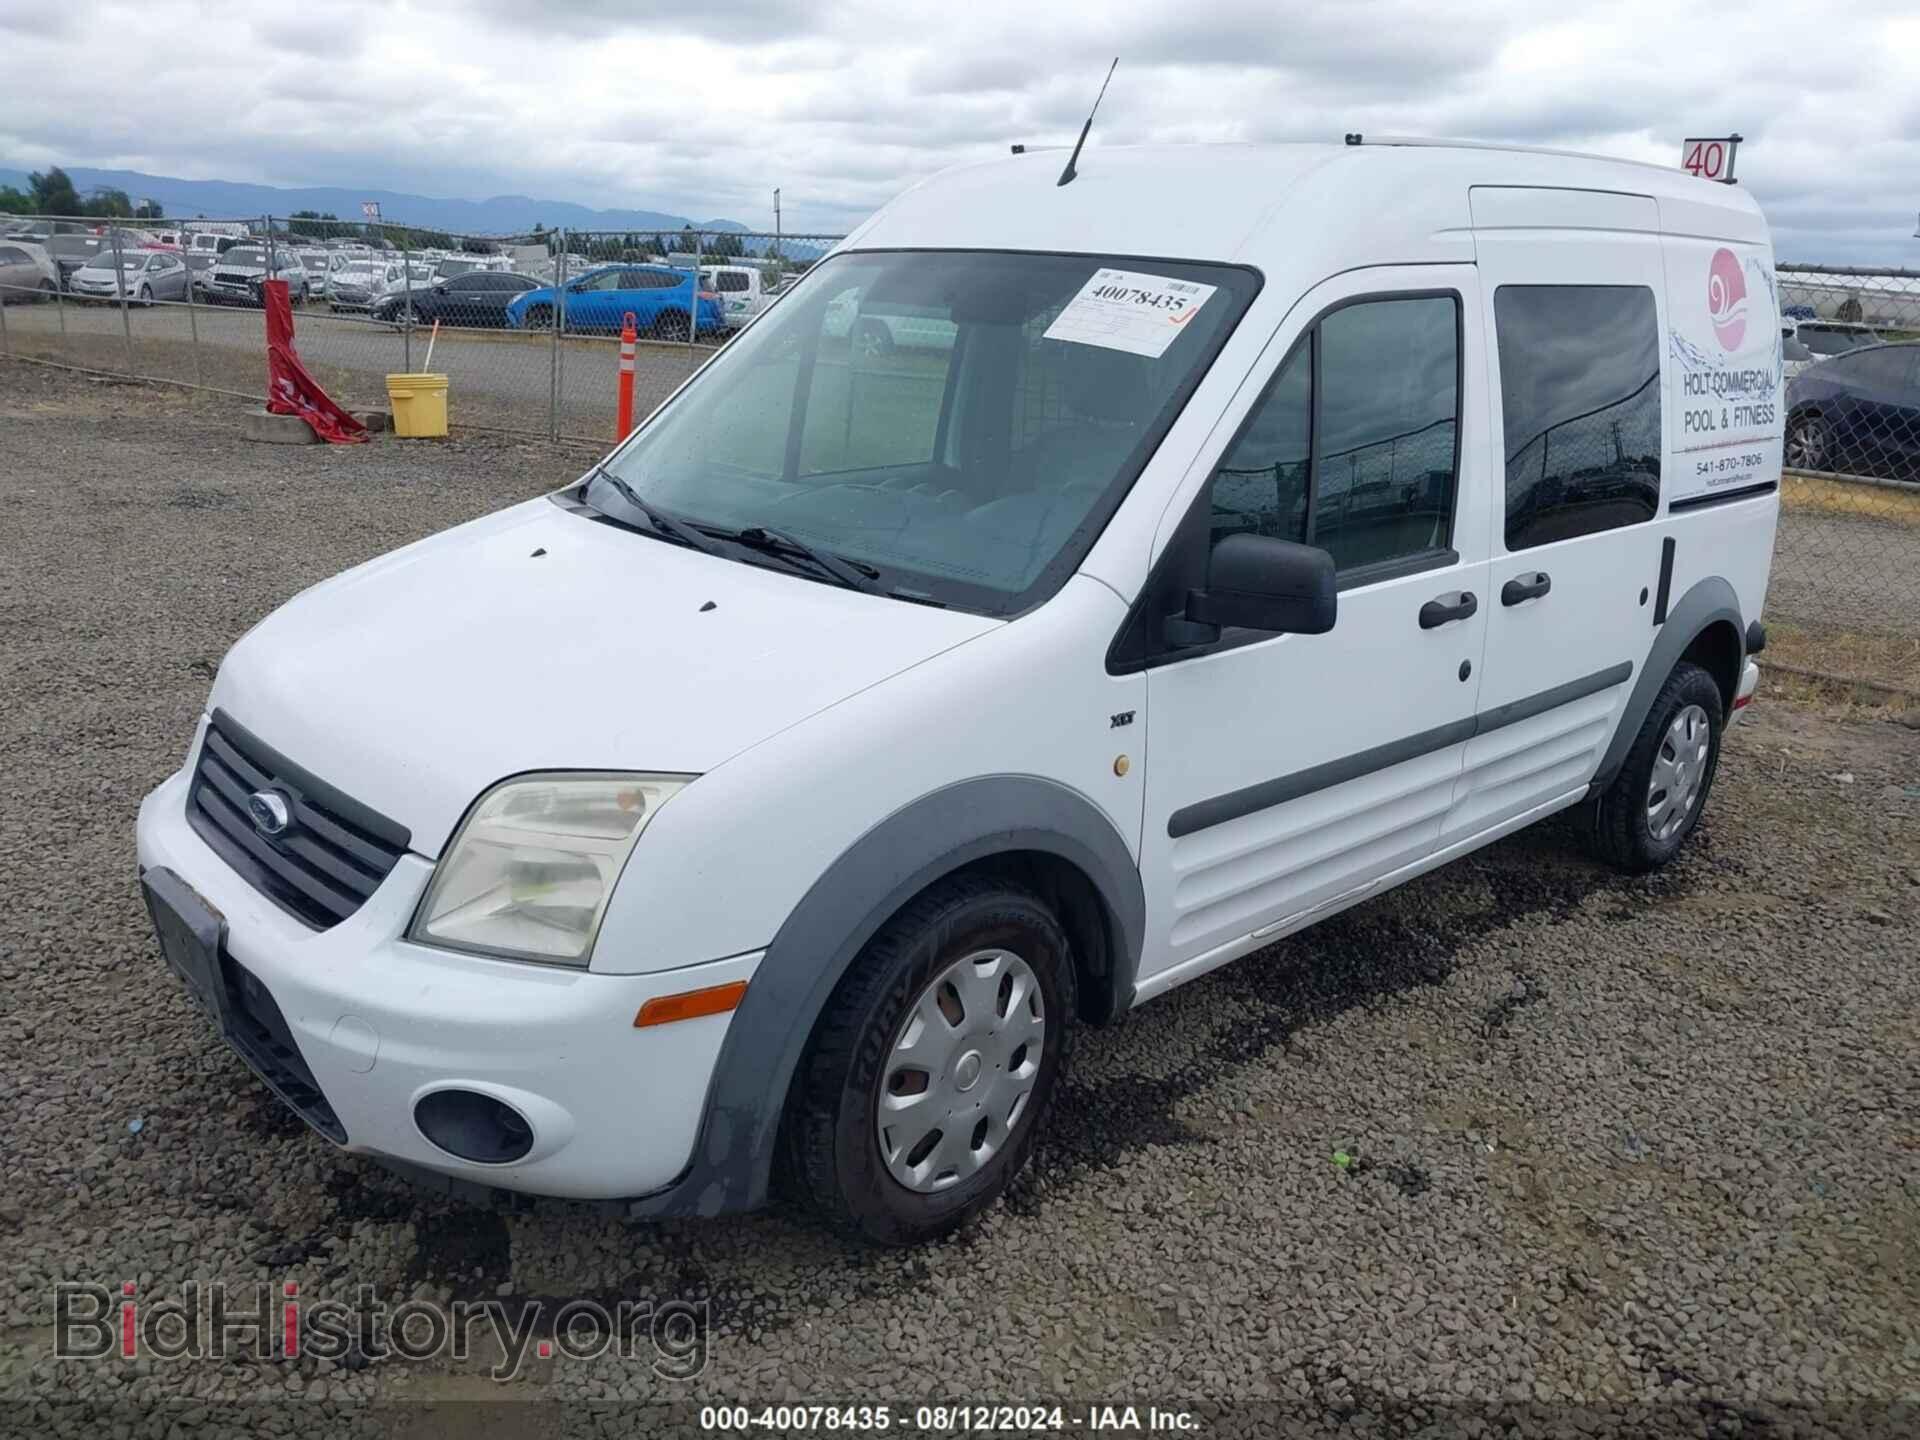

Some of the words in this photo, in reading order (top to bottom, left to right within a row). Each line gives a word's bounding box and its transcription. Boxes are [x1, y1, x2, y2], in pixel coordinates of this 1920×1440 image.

[1685, 143, 1722, 177] 40
[1092, 285, 1188, 311] 40078435
[1684, 372, 1711, 396] HOLT
[1713, 369, 1774, 393] COMMERCIAL
[1685, 408, 1716, 433] POOL
[1721, 407, 1729, 429] &
[1734, 403, 1775, 427] FITNESS
[1696, 453, 1762, 475] 541-870-7806
[1110, 710, 1136, 728] XLT
